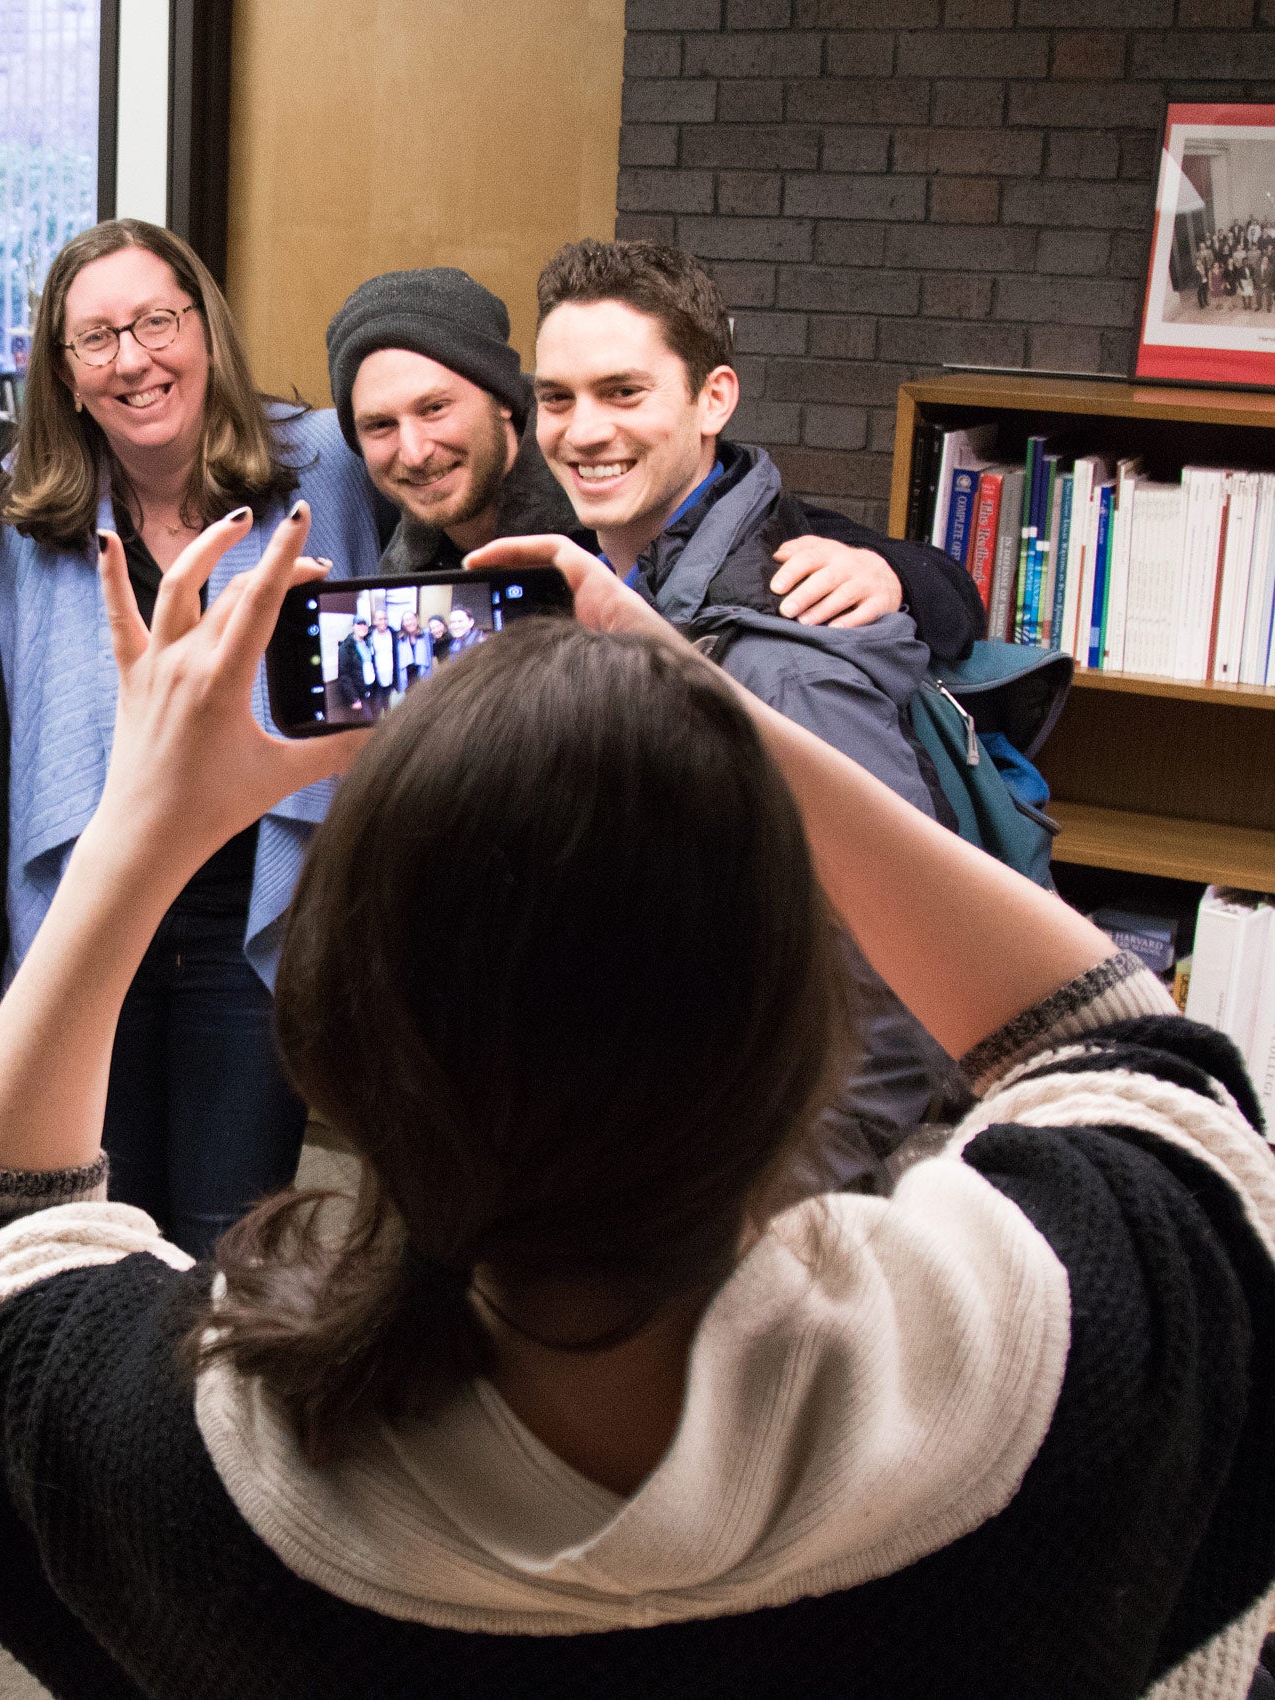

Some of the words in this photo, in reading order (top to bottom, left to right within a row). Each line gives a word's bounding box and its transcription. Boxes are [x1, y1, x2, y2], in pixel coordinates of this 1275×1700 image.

[952, 495, 968, 541] COMPLETE
[980, 500, 993, 525] The
[973, 527, 991, 584] Redbook
[1000, 549, 1012, 588] DEFENSE
[995, 603, 1005, 638] WOMEN
[1115, 932, 1164, 951] HARVARD
